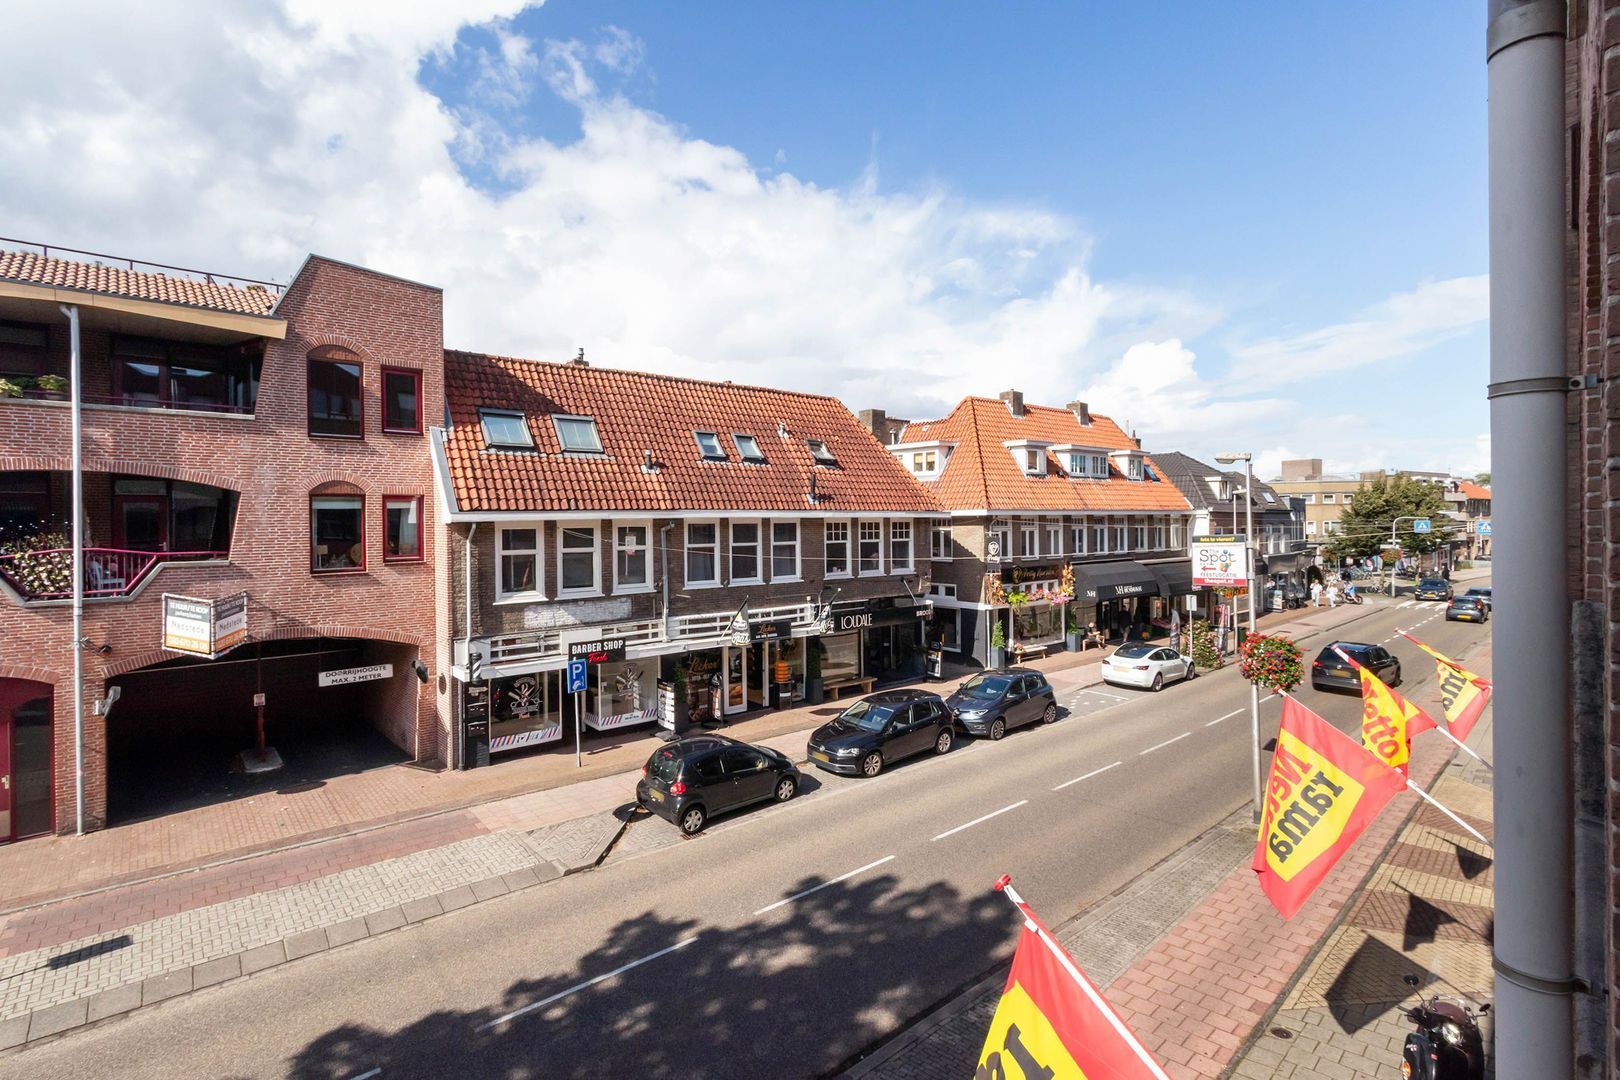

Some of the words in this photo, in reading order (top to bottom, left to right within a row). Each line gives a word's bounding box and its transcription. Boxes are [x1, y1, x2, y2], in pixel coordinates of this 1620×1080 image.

[1199, 549, 1237, 566] Spot
[841, 613, 873, 630] LOUDALE
[571, 643, 602, 654] BARBER
[603, 640, 624, 651] SHOP
[325, 666, 387, 678] DOORRIJHOOGTE
[358, 673, 381, 681] METER
[572, 664, 582, 680] P
